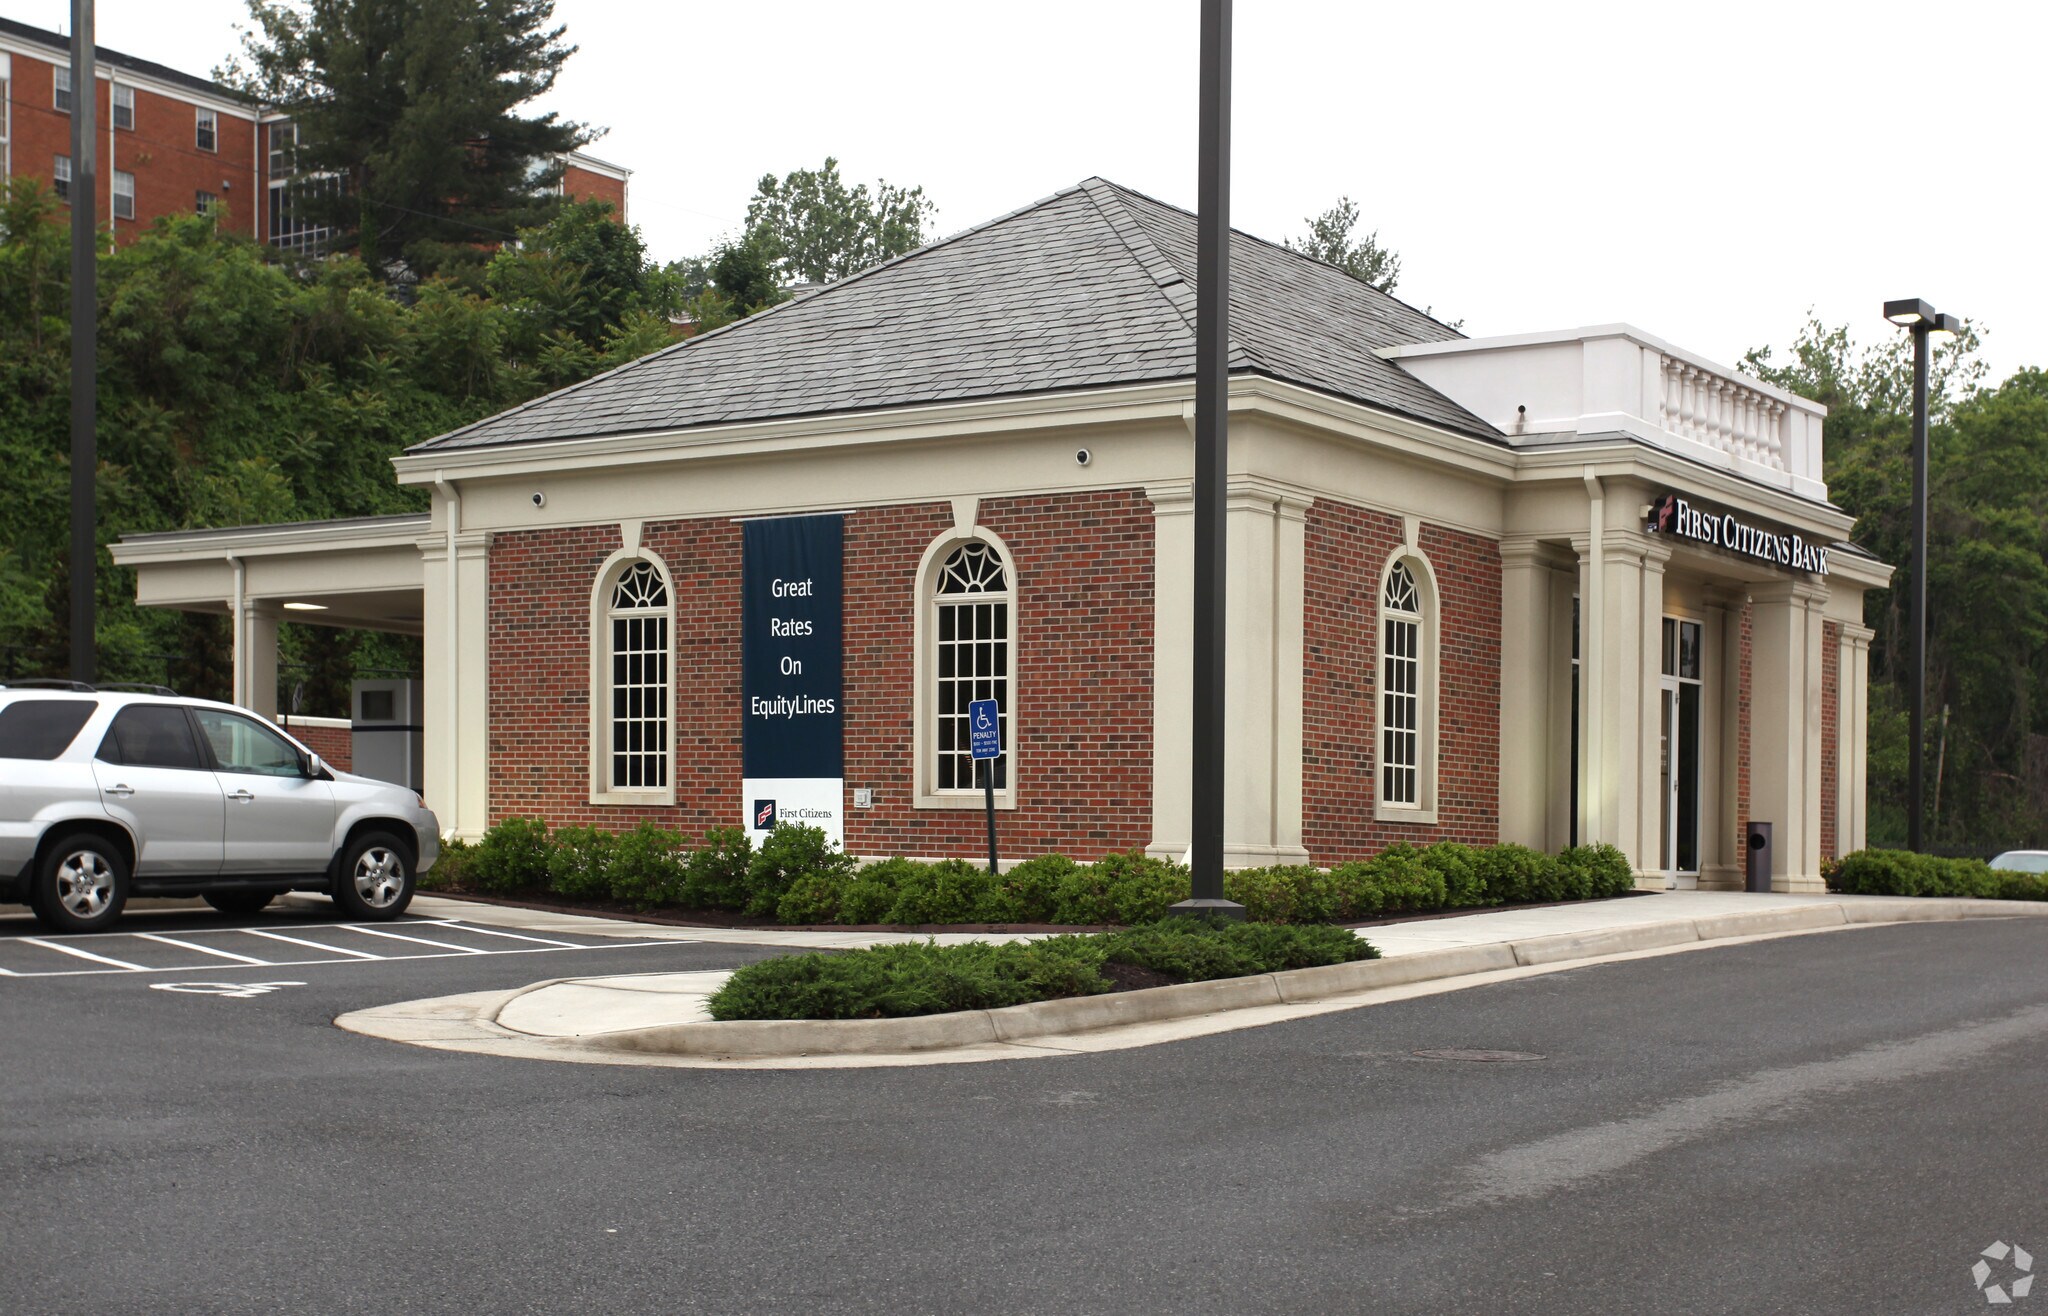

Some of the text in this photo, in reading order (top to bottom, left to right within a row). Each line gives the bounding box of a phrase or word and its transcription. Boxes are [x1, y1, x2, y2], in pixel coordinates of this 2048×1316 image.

[1676, 499, 1829, 575] FIRST CITIZENS BANK
[772, 578, 812, 597] Great
[771, 618, 813, 636] Rates
[780, 656, 801, 675] On
[751, 694, 835, 719] EquityLines
[973, 731, 997, 740] PENALTY
[780, 808, 832, 819] First Citizens
